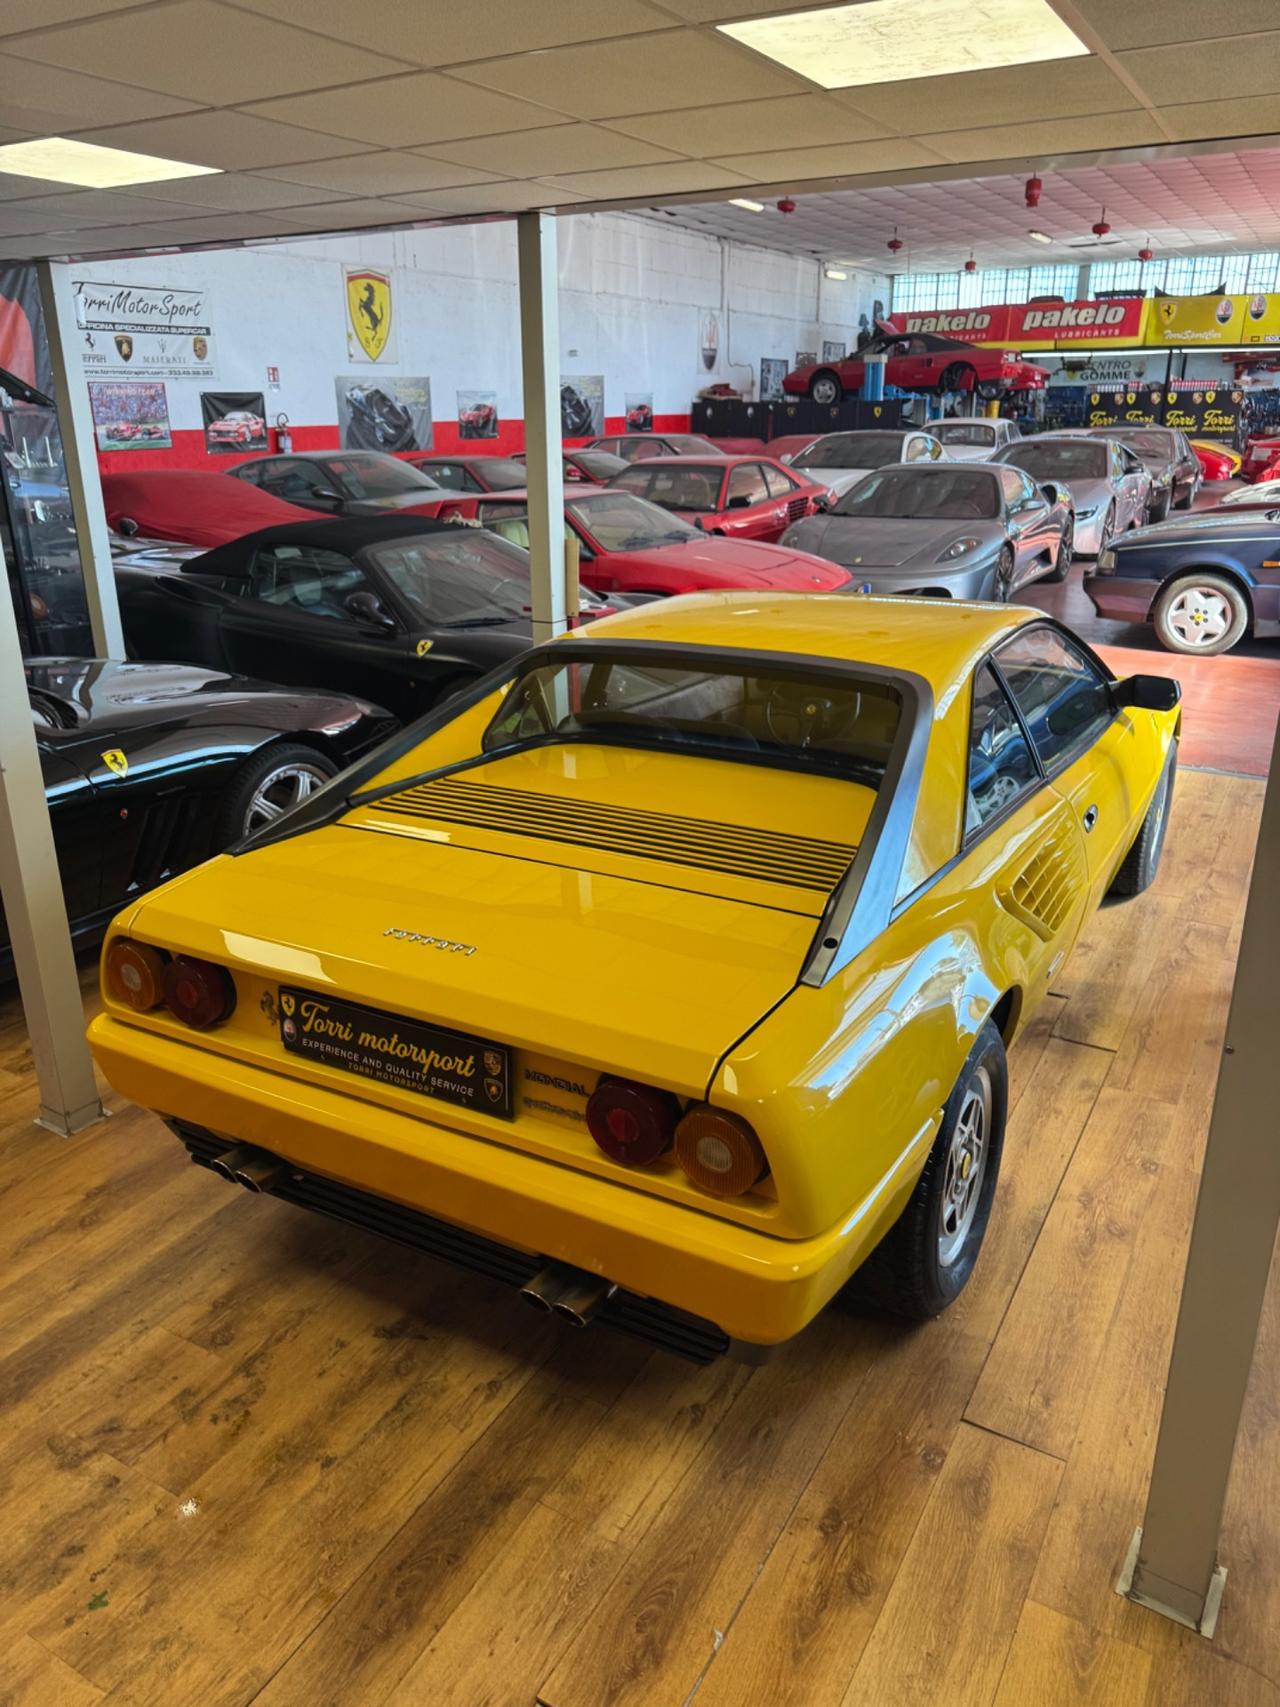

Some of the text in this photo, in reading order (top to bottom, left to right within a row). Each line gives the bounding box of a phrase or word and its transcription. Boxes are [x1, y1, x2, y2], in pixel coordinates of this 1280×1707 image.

[906, 312, 992, 334] pakelo
[1022, 303, 1126, 332] pakelo
[950, 333, 987, 341] RICANTS
[1054, 328, 1120, 339] LUBRICANTS
[1080, 370, 1131, 381] GOMME
[1092, 360, 1132, 370] ENTRO
[1166, 410, 1196, 427] Torri
[1203, 409, 1235, 426] Torri
[383, 928, 478, 956] Ferrari
[300, 1001, 477, 1078] Torri motorsport
[302, 1038, 475, 1097] EXPERIENCE AND QUALITY SERVICE
[348, 1062, 436, 1094] TORRI MOTORSPORT
[525, 1068, 591, 1097] MONDIAL
